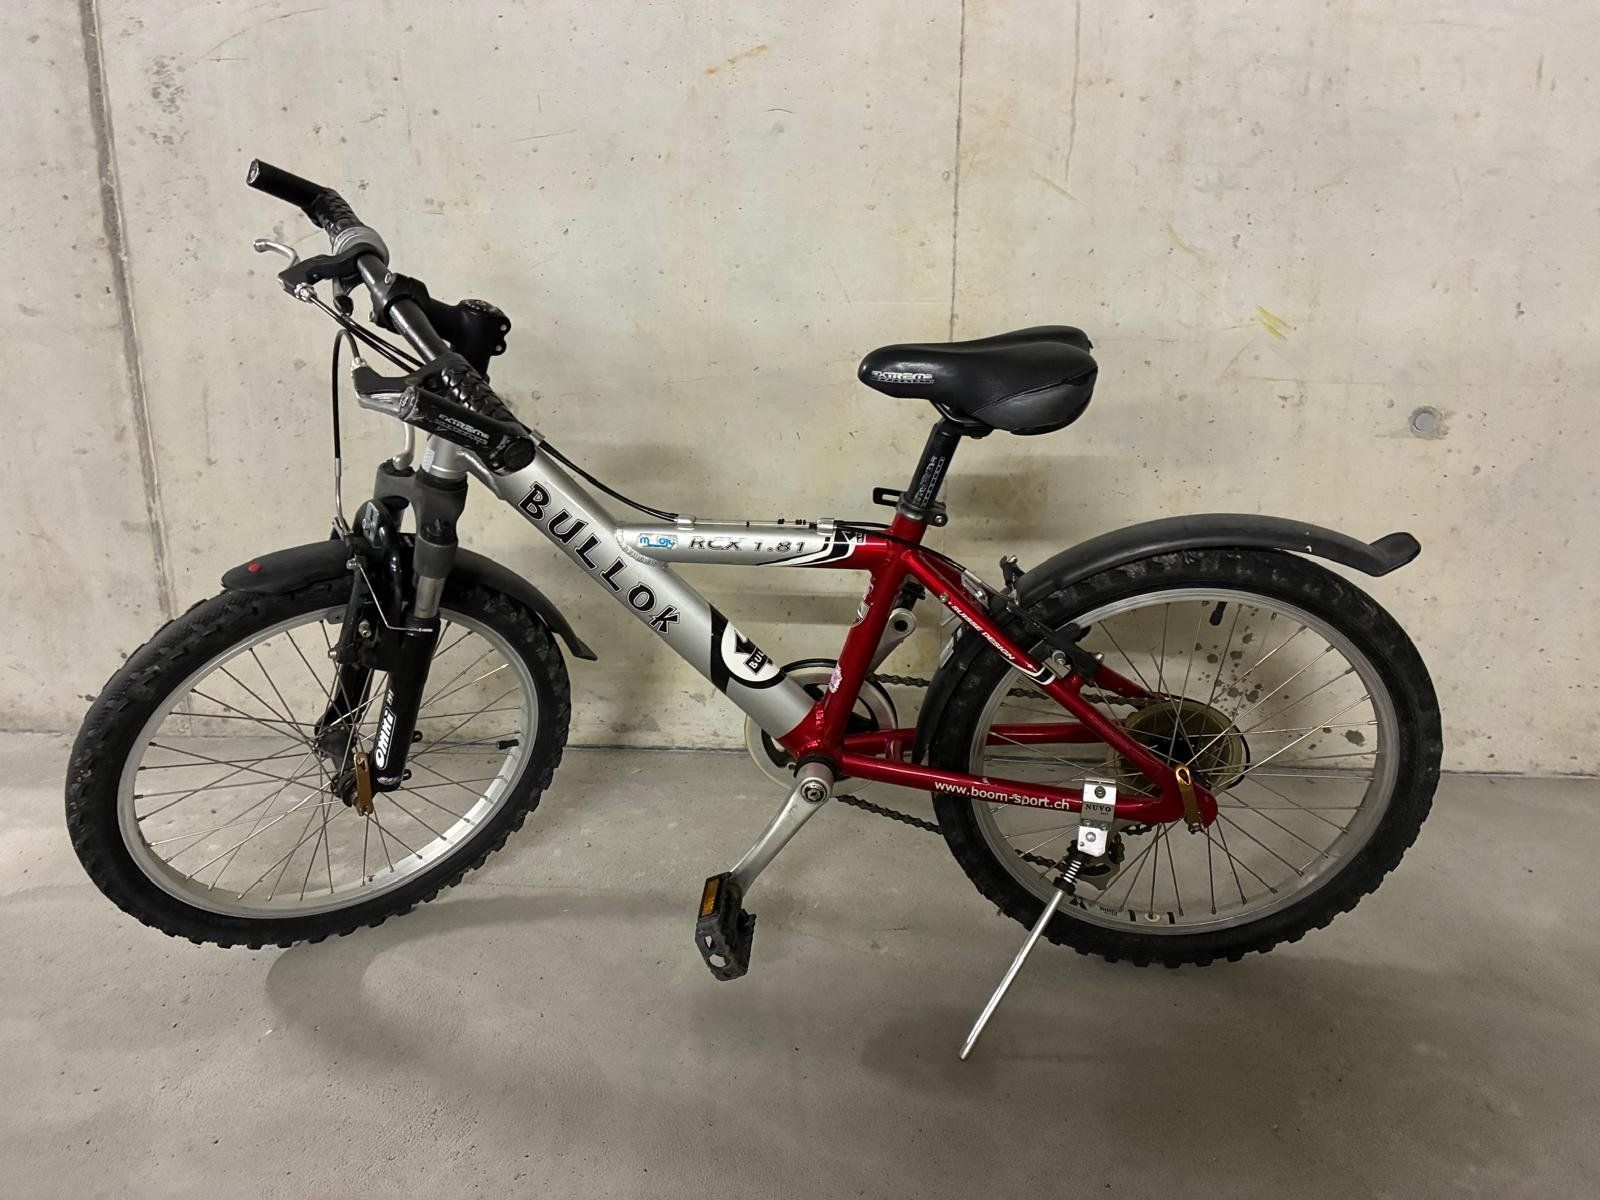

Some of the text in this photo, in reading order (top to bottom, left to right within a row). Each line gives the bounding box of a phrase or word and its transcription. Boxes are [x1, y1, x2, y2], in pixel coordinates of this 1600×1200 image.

[517, 480, 681, 635] BULLOK
[688, 535, 805, 553] RCX 1.81
[981, 632, 1016, 660] DESIGN
[934, 781, 1070, 811] www.boom-sport.ch
[1085, 803, 1112, 813] NUVO
